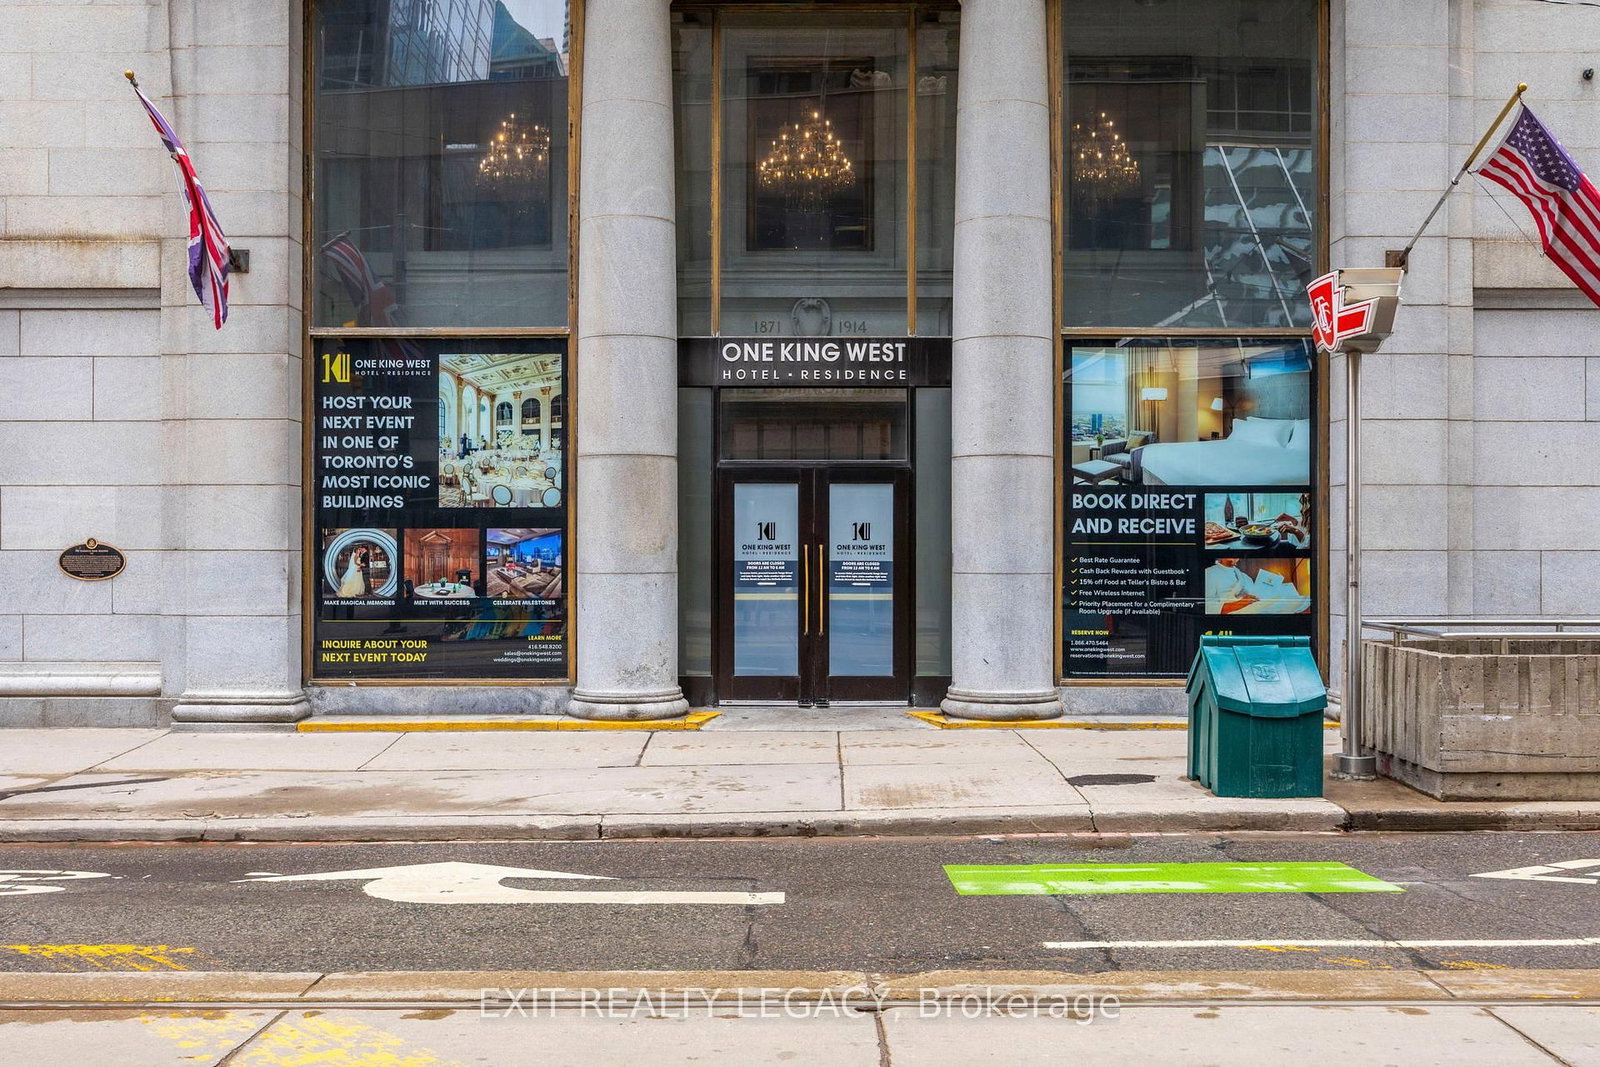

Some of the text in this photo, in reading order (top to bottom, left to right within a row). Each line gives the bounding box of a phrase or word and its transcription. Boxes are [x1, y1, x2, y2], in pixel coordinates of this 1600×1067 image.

[754, 320, 781, 333] 1871
[839, 320, 867, 333] 1914
[722, 342, 906, 362] ONE KING WEST
[355, 359, 431, 368] ONE KING WEST
[723, 369, 906, 380] HOTEL RESIDENCE
[322, 396, 412, 409] HOST YOUR
[322, 416, 414, 429] NEXT EVENT
[322, 436, 399, 449] IN ONE OF
[322, 456, 414, 469] TORONTO'S
[322, 476, 430, 489] MOST ICONIC
[322, 495, 404, 509] BUILDINGS
[1072, 494, 1196, 510] BOOK DIRECT
[1072, 518, 1196, 534] AND RECEIVE
[322, 640, 428, 649] INQUIRE ABOUT YOUR
[322, 653, 427, 662] NEXT EVENT TODAY
